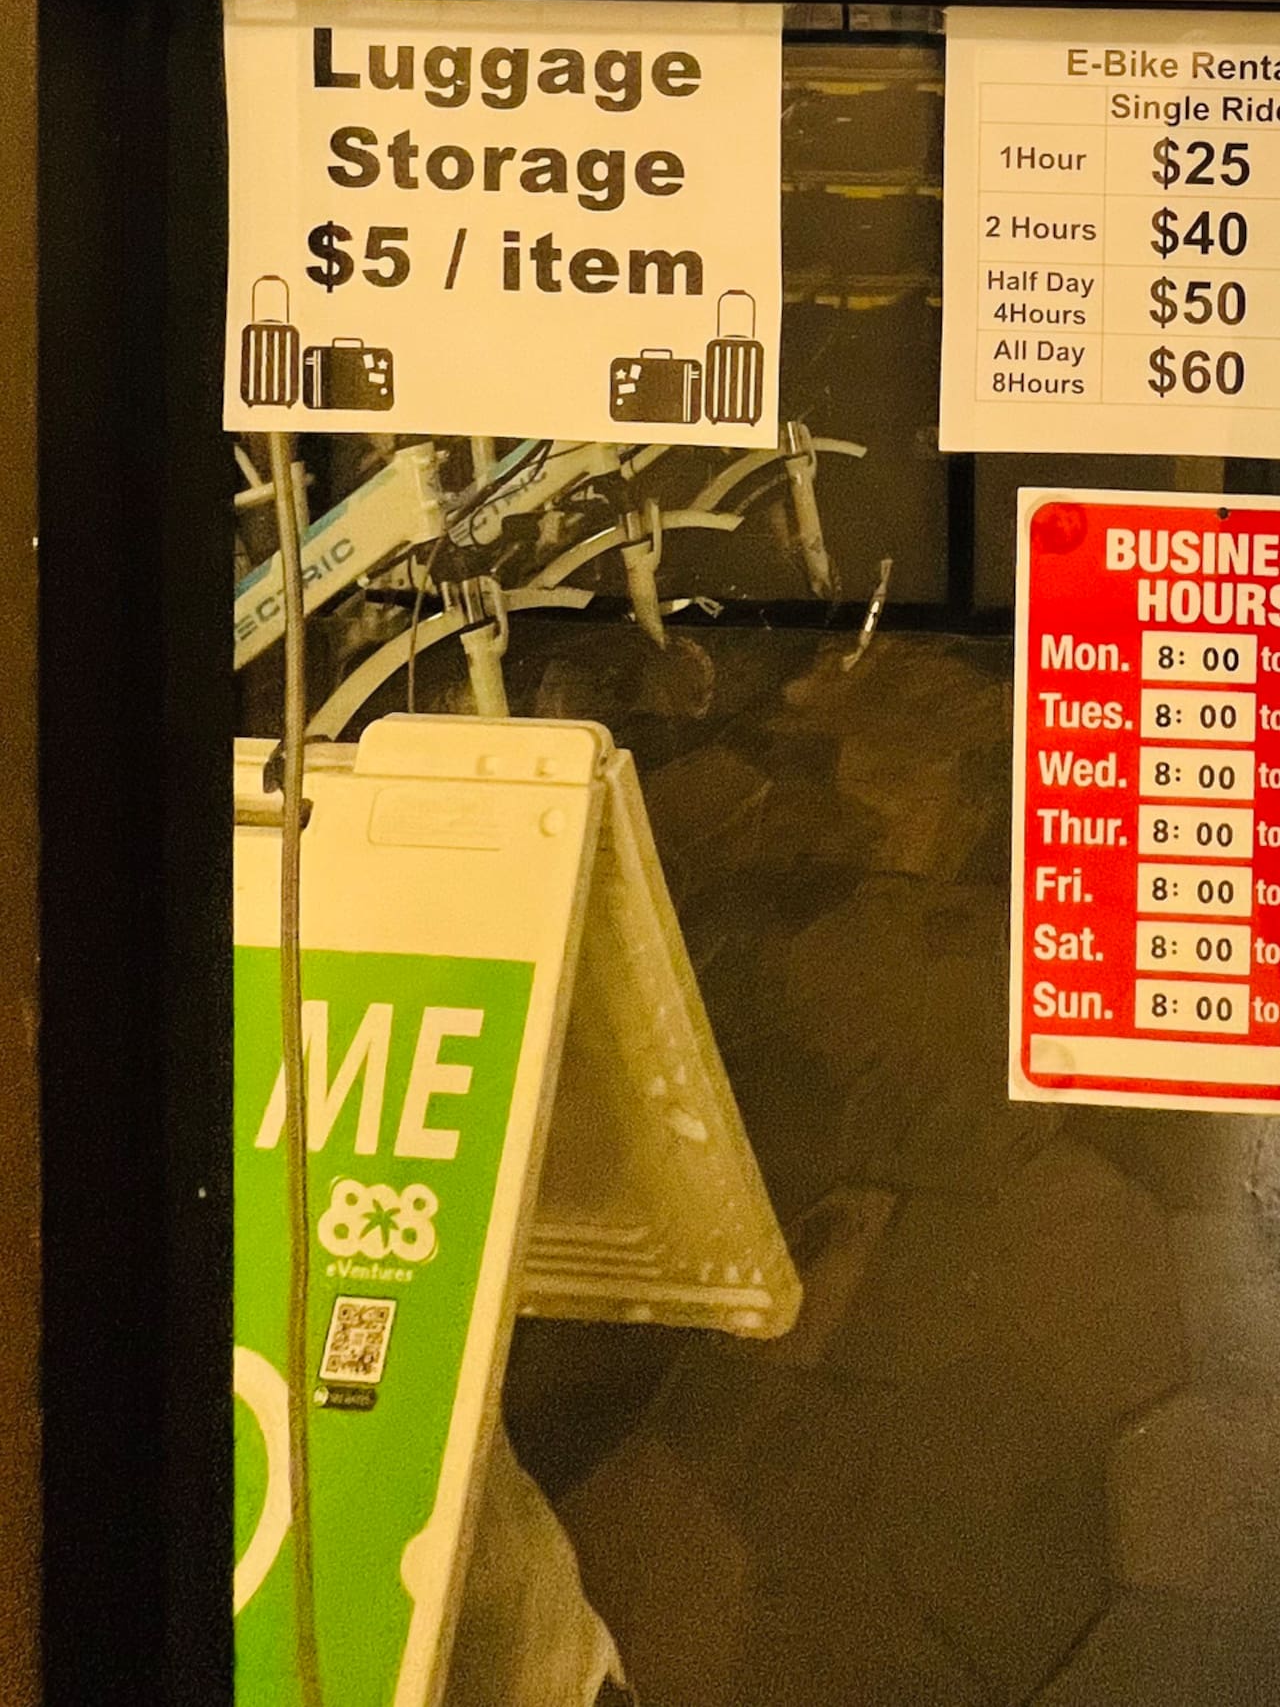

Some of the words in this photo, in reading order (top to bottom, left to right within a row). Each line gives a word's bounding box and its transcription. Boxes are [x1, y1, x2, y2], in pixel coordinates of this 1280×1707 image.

[313, 28, 702, 112] Luggage
[1067, 49, 1179, 78] E-Bike
[1111, 93, 1210, 127] Single
[327, 126, 685, 211] Storage
[1000, 146, 1087, 171] 1Hour
[1152, 137, 1251, 189] $25
[985, 216, 1001, 239] 2
[1011, 217, 1097, 241] Hours
[1150, 207, 1248, 259] $40
[305, 220, 411, 293] $5
[444, 228, 467, 290] /
[502, 231, 704, 295] item
[987, 270, 1038, 293] Half
[1046, 273, 1095, 298] Day
[1149, 276, 1247, 329] $50
[993, 303, 1087, 326] 4Hours
[993, 340, 1028, 361] All
[1036, 341, 1086, 367] Day
[1147, 346, 1245, 398] $60
[992, 373, 1085, 395] 8Hours
[1040, 634, 1130, 673] Mon.
[1039, 692, 1133, 730] Tues.
[1037, 750, 1128, 788] Wed.
[1036, 809, 1128, 847] Thur.
[1035, 866, 1094, 903] Fri.
[1033, 924, 1104, 961] Sat.
[1032, 981, 1113, 1021] Sun.
[1252, 996, 1280, 1023] to
